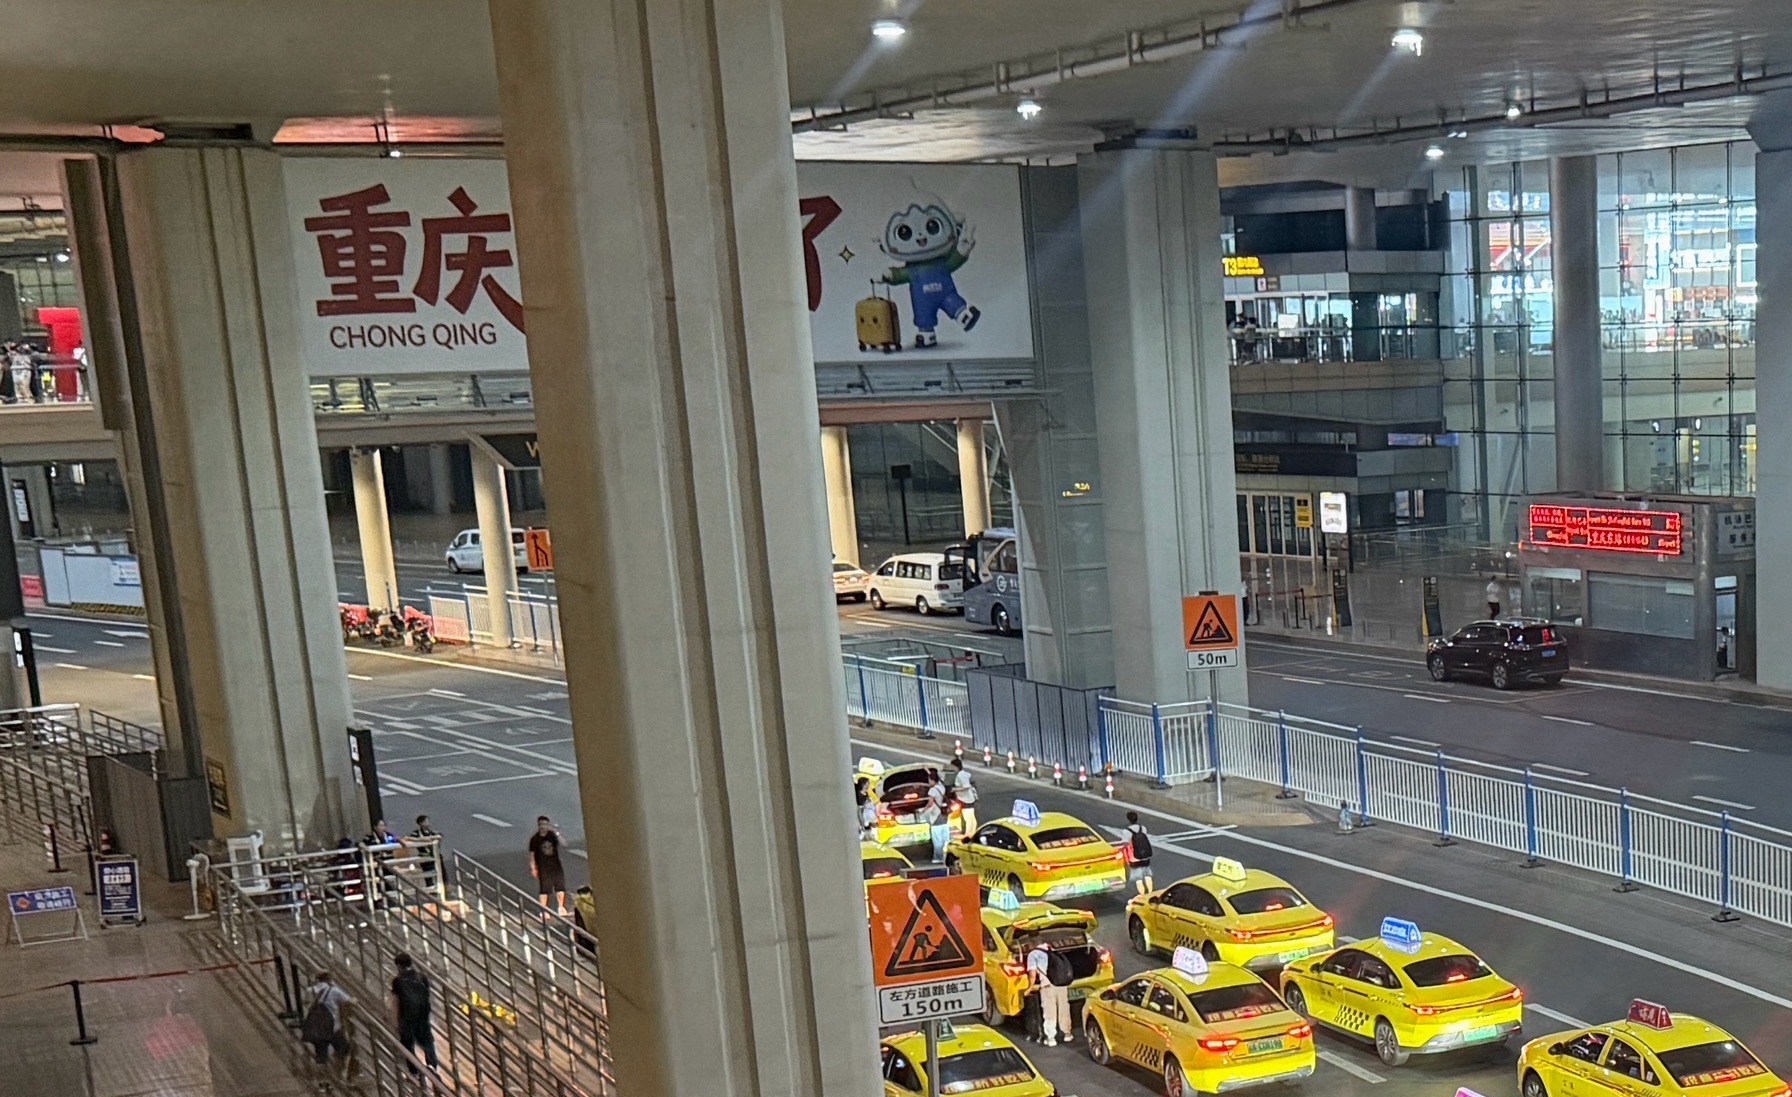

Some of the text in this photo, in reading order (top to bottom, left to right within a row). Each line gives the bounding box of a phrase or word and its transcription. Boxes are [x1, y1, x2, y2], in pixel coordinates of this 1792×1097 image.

[329, 322, 497, 349] CHONG QING
[1197, 652, 1228, 667] 50m
[890, 981, 972, 1002] 左方道路施工
[902, 998, 962, 1017] 150m
